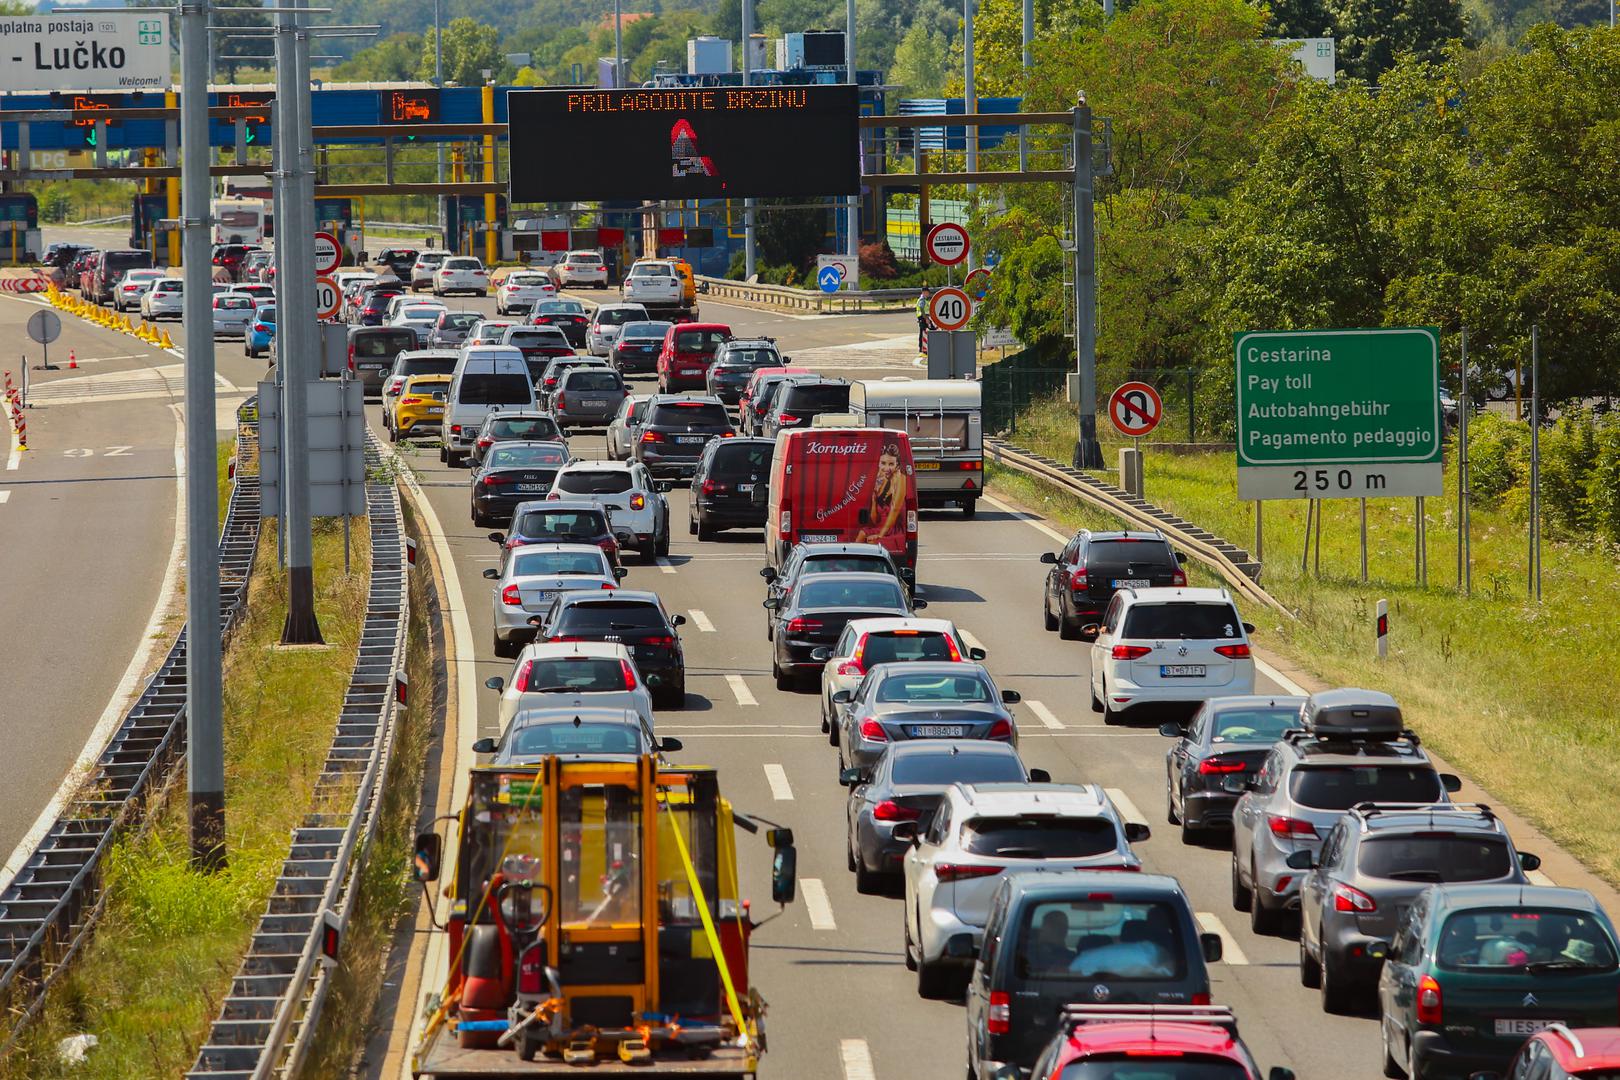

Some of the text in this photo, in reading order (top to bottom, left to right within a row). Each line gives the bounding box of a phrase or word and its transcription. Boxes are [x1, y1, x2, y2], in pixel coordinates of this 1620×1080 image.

[48, 20, 94, 34] postaja
[34, 41, 125, 70] Lučko
[118, 76, 162, 87] Welcome!
[567, 89, 807, 112] PRILAGODITE BRZINU
[31, 152, 65, 168] LPG
[939, 301, 962, 319] 40
[1247, 346, 1332, 363] Cestarina
[1248, 374, 1312, 393] Pay toll
[1248, 401, 1390, 420] Autobahngebühr
[1250, 427, 1431, 450] Pagamento pedaggio
[806, 442, 868, 456] Kornspitz
[1293, 469, 1386, 491] 250 m
